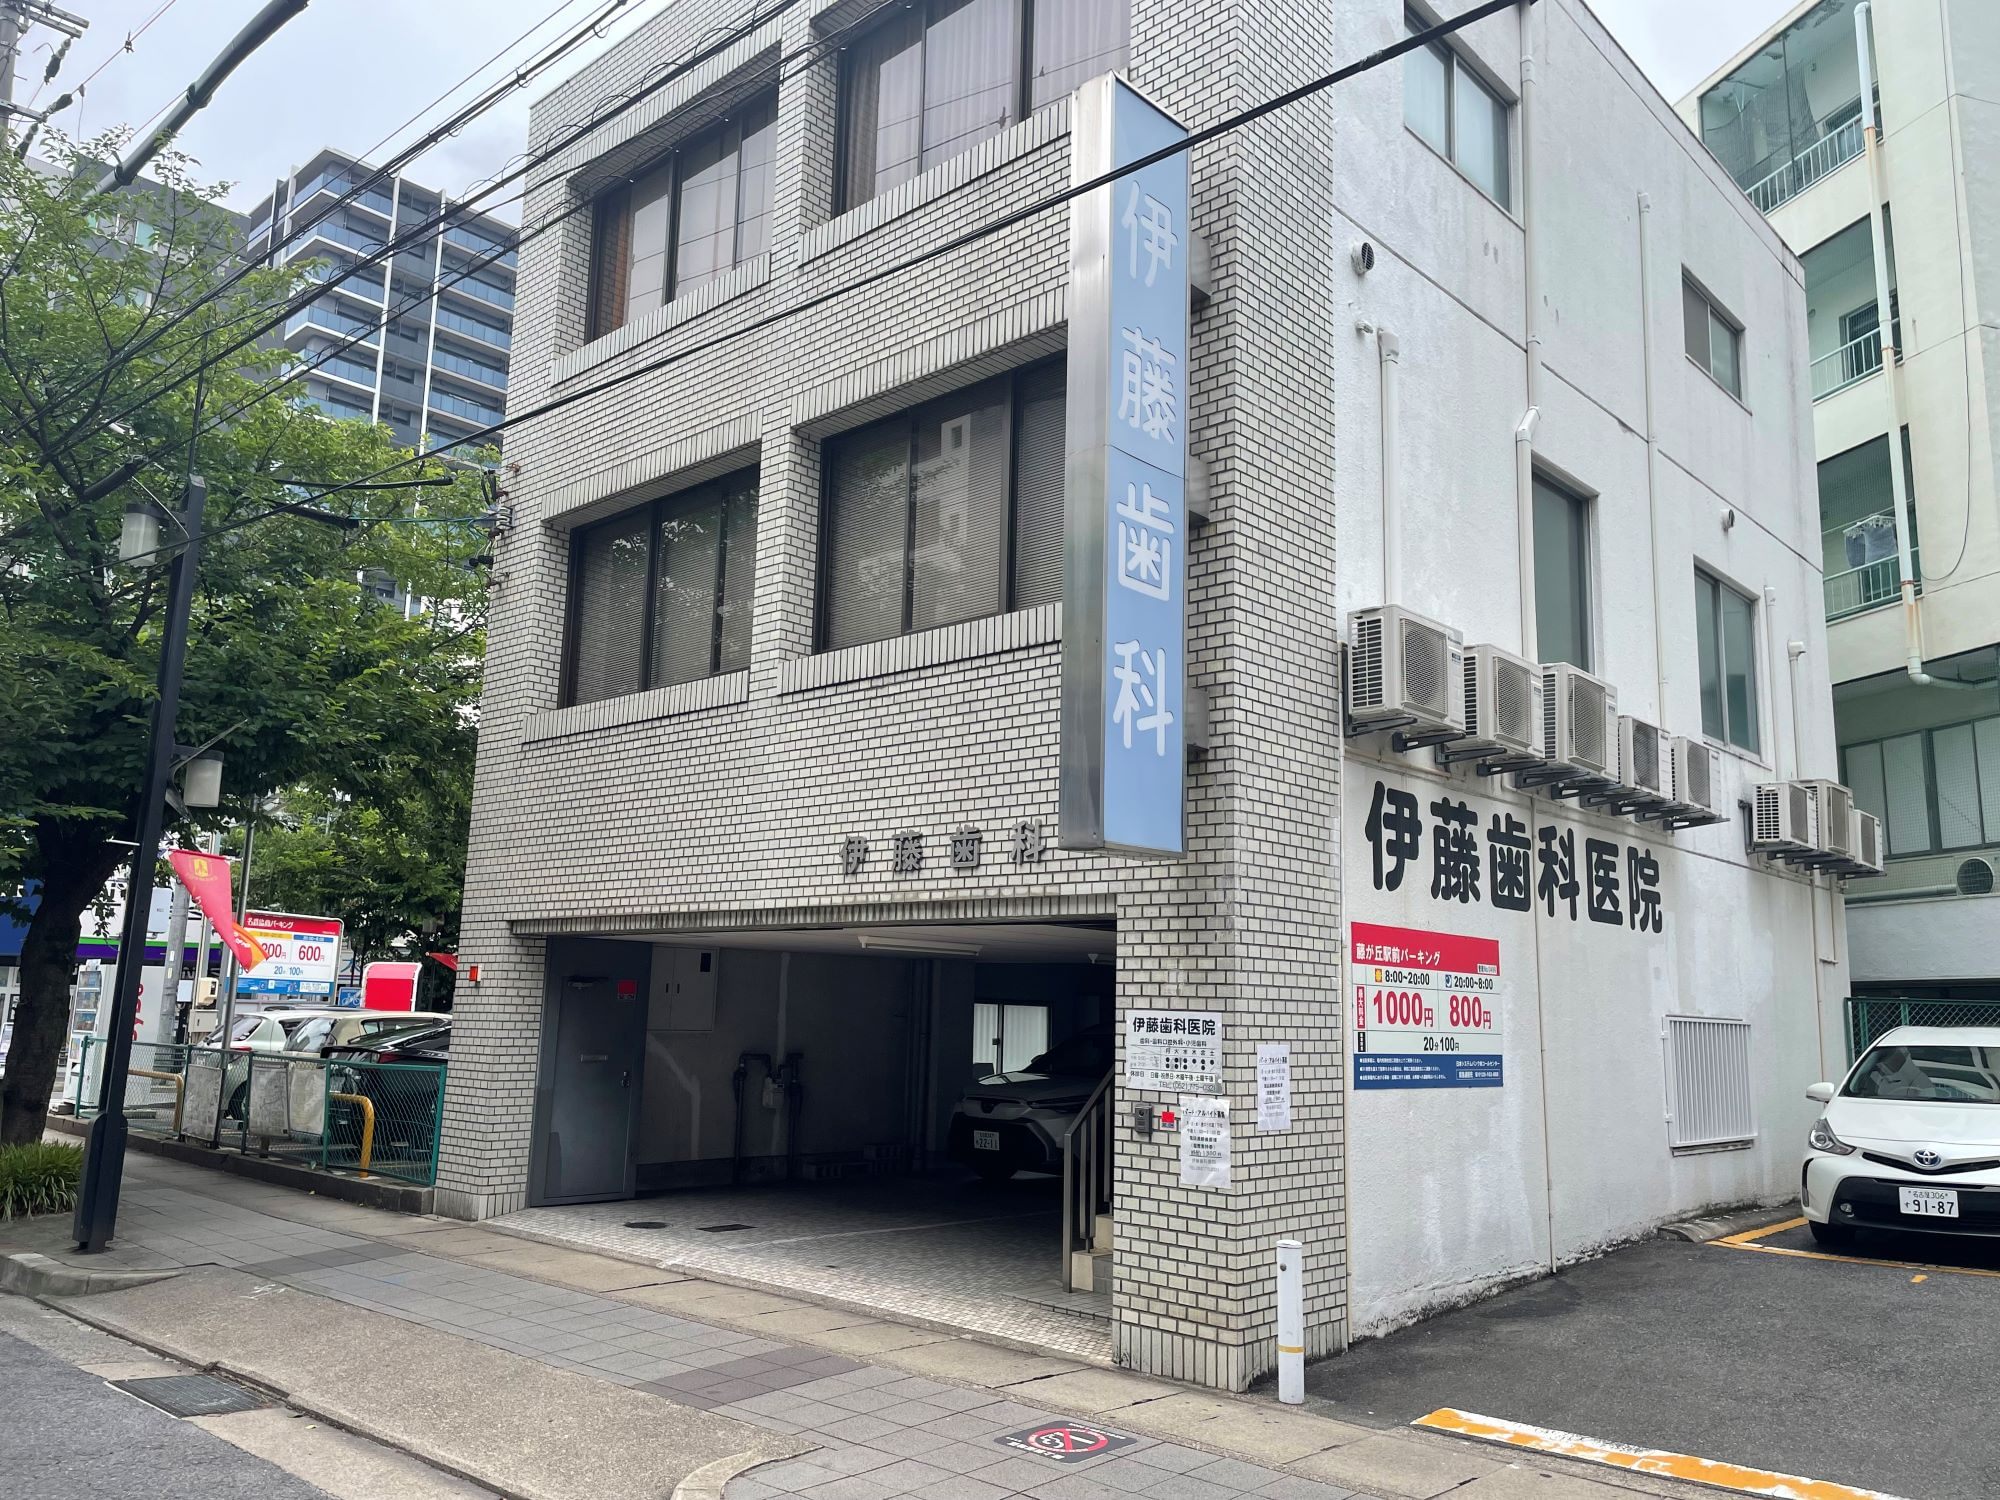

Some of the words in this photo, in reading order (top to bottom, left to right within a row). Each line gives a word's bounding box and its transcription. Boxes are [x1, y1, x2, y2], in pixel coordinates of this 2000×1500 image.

[1112, 180, 1179, 757] 伊藤歯科
[839, 818, 1046, 875] 伊藤歯科
[1365, 780, 1663, 934] 伊藤歯科医院
[1355, 943, 1441, 966] 藤が丘駅前パーキング
[1132, 1016, 1216, 1036] 伊藤歯科医院
[1373, 989, 1434, 1028] 1000円
[1449, 994, 1492, 1030] 800円
[1913, 1199, 1954, 1214] 91-87
